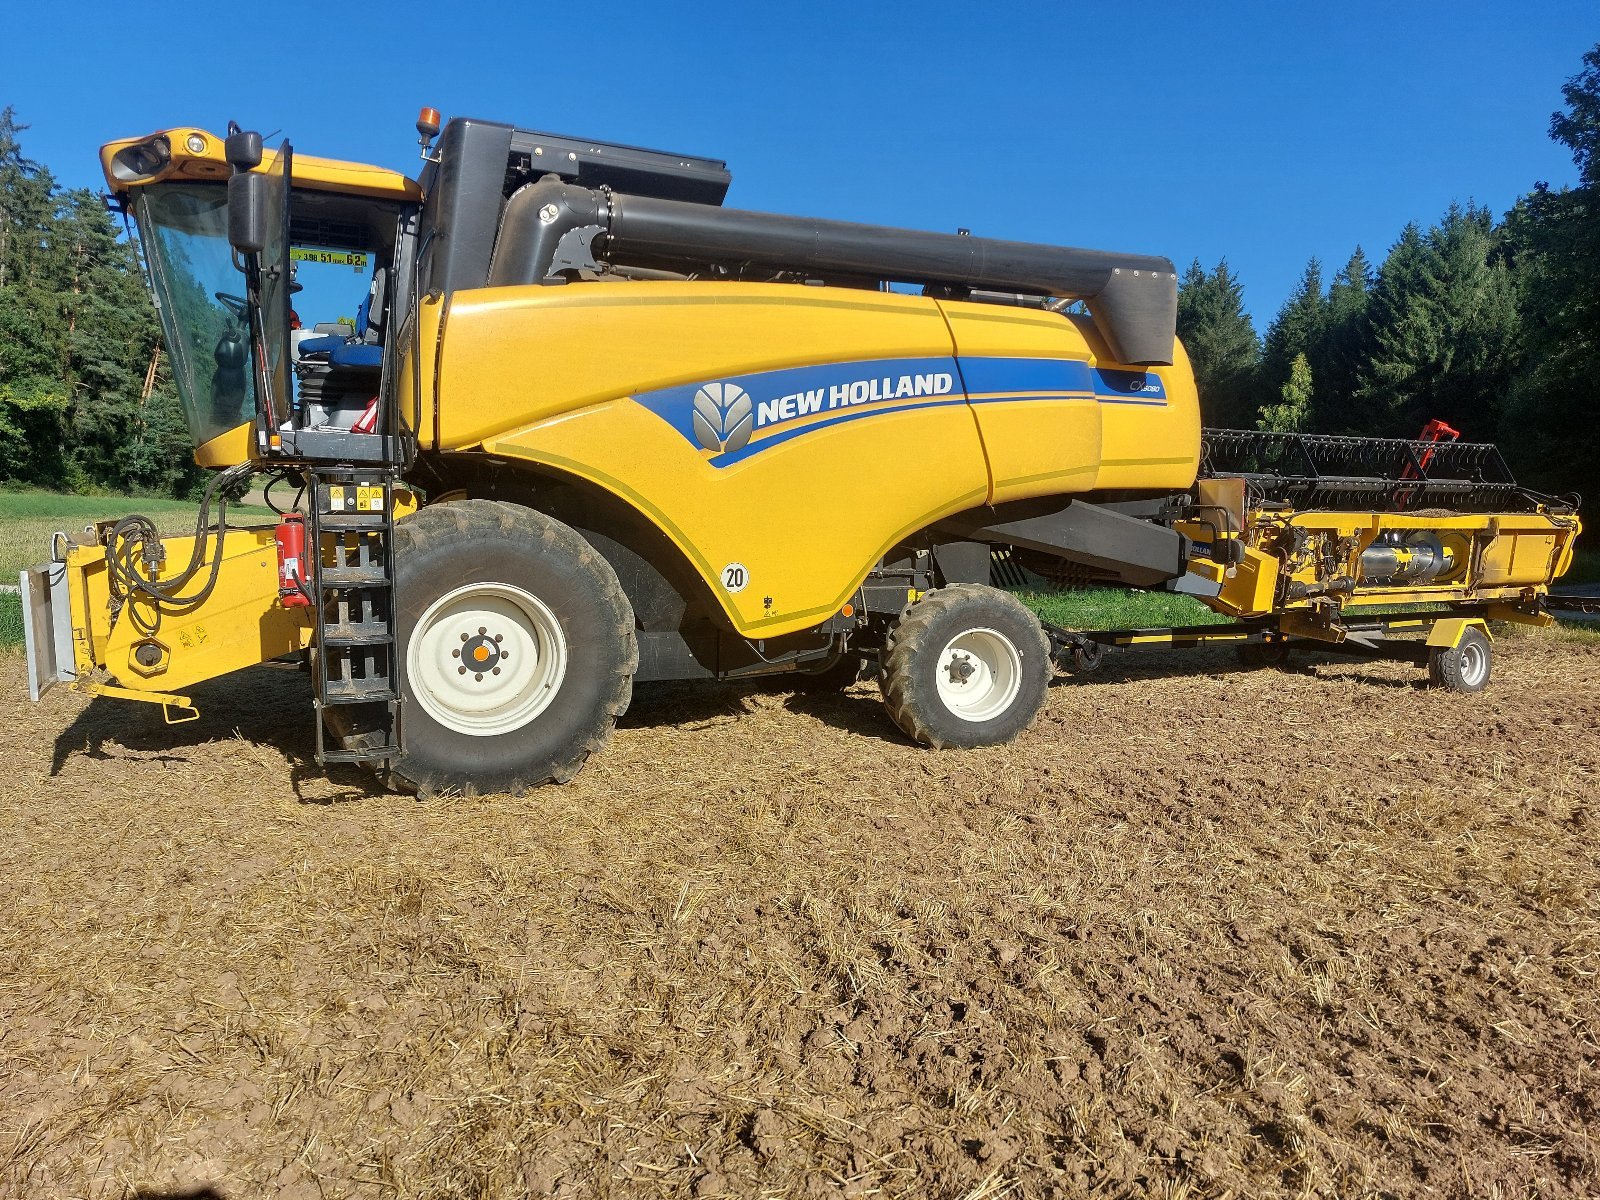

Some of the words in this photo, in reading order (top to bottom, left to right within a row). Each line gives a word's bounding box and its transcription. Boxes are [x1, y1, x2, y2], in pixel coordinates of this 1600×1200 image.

[757, 388, 824, 426] NEW
[829, 373, 953, 409] HOLLAND
[726, 567, 744, 588] 20
